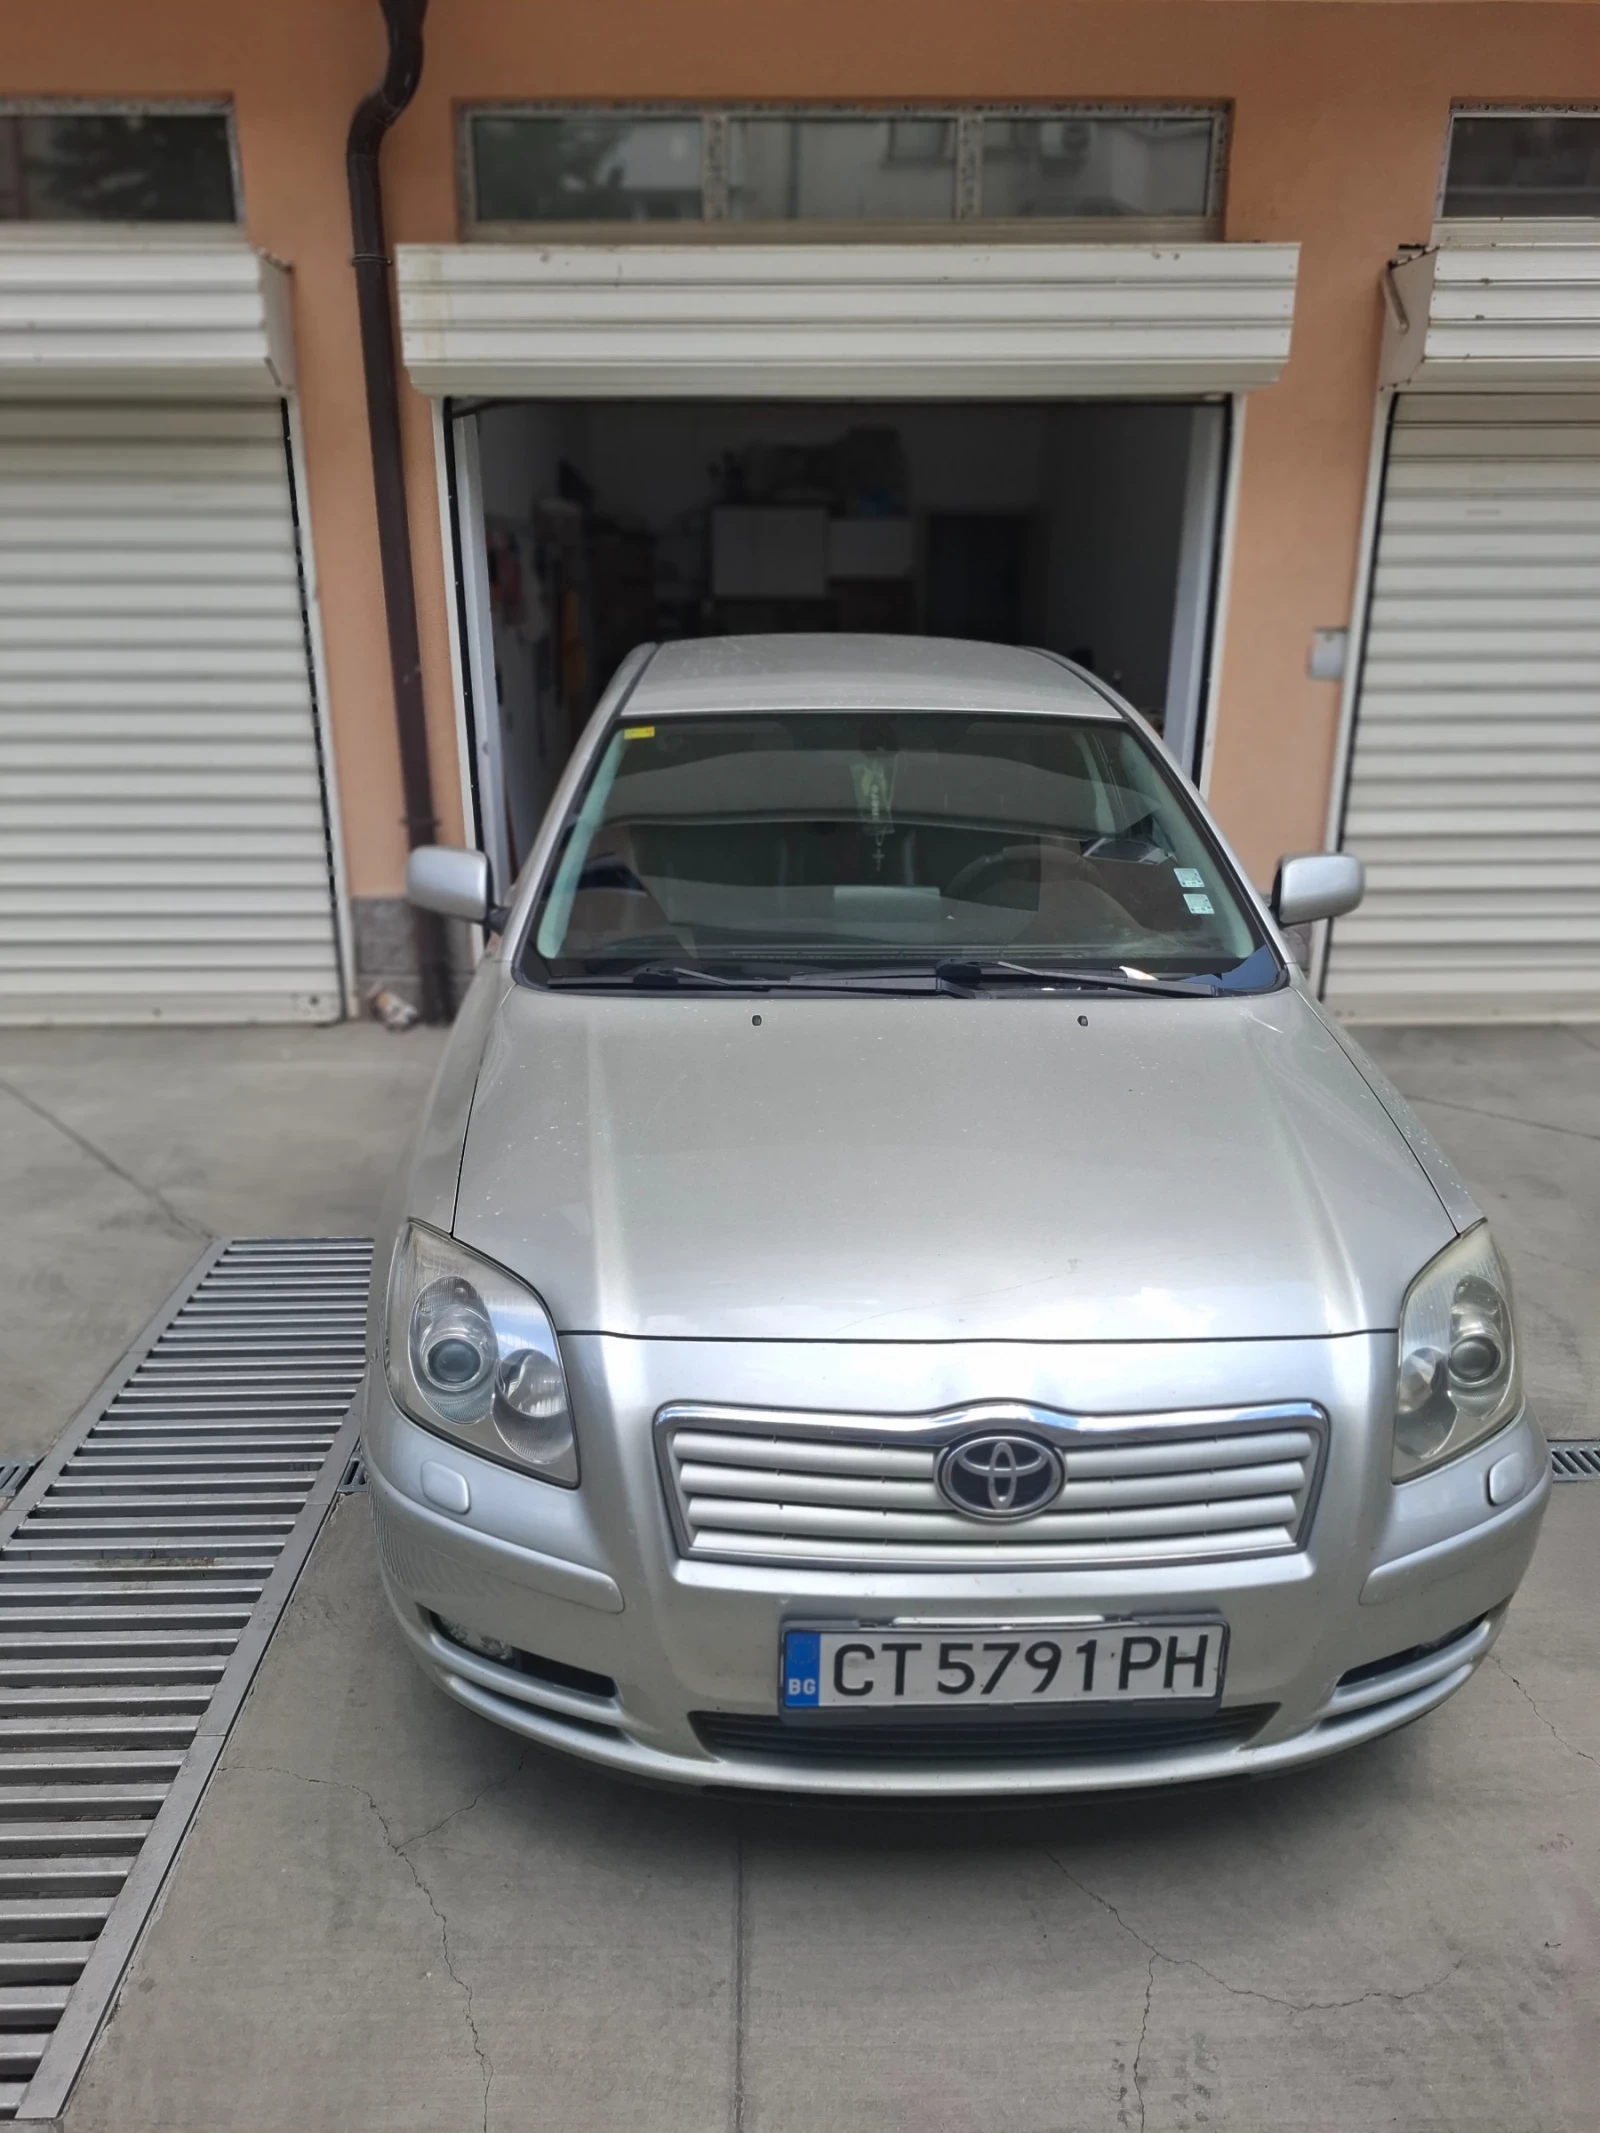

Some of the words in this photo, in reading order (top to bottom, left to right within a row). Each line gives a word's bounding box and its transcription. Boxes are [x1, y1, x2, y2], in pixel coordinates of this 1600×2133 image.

[833, 1643, 922, 1697] CT
[937, 1639, 1098, 1695] 5791
[1118, 1634, 1208, 1690] PH
[788, 1679, 817, 1695] BG
